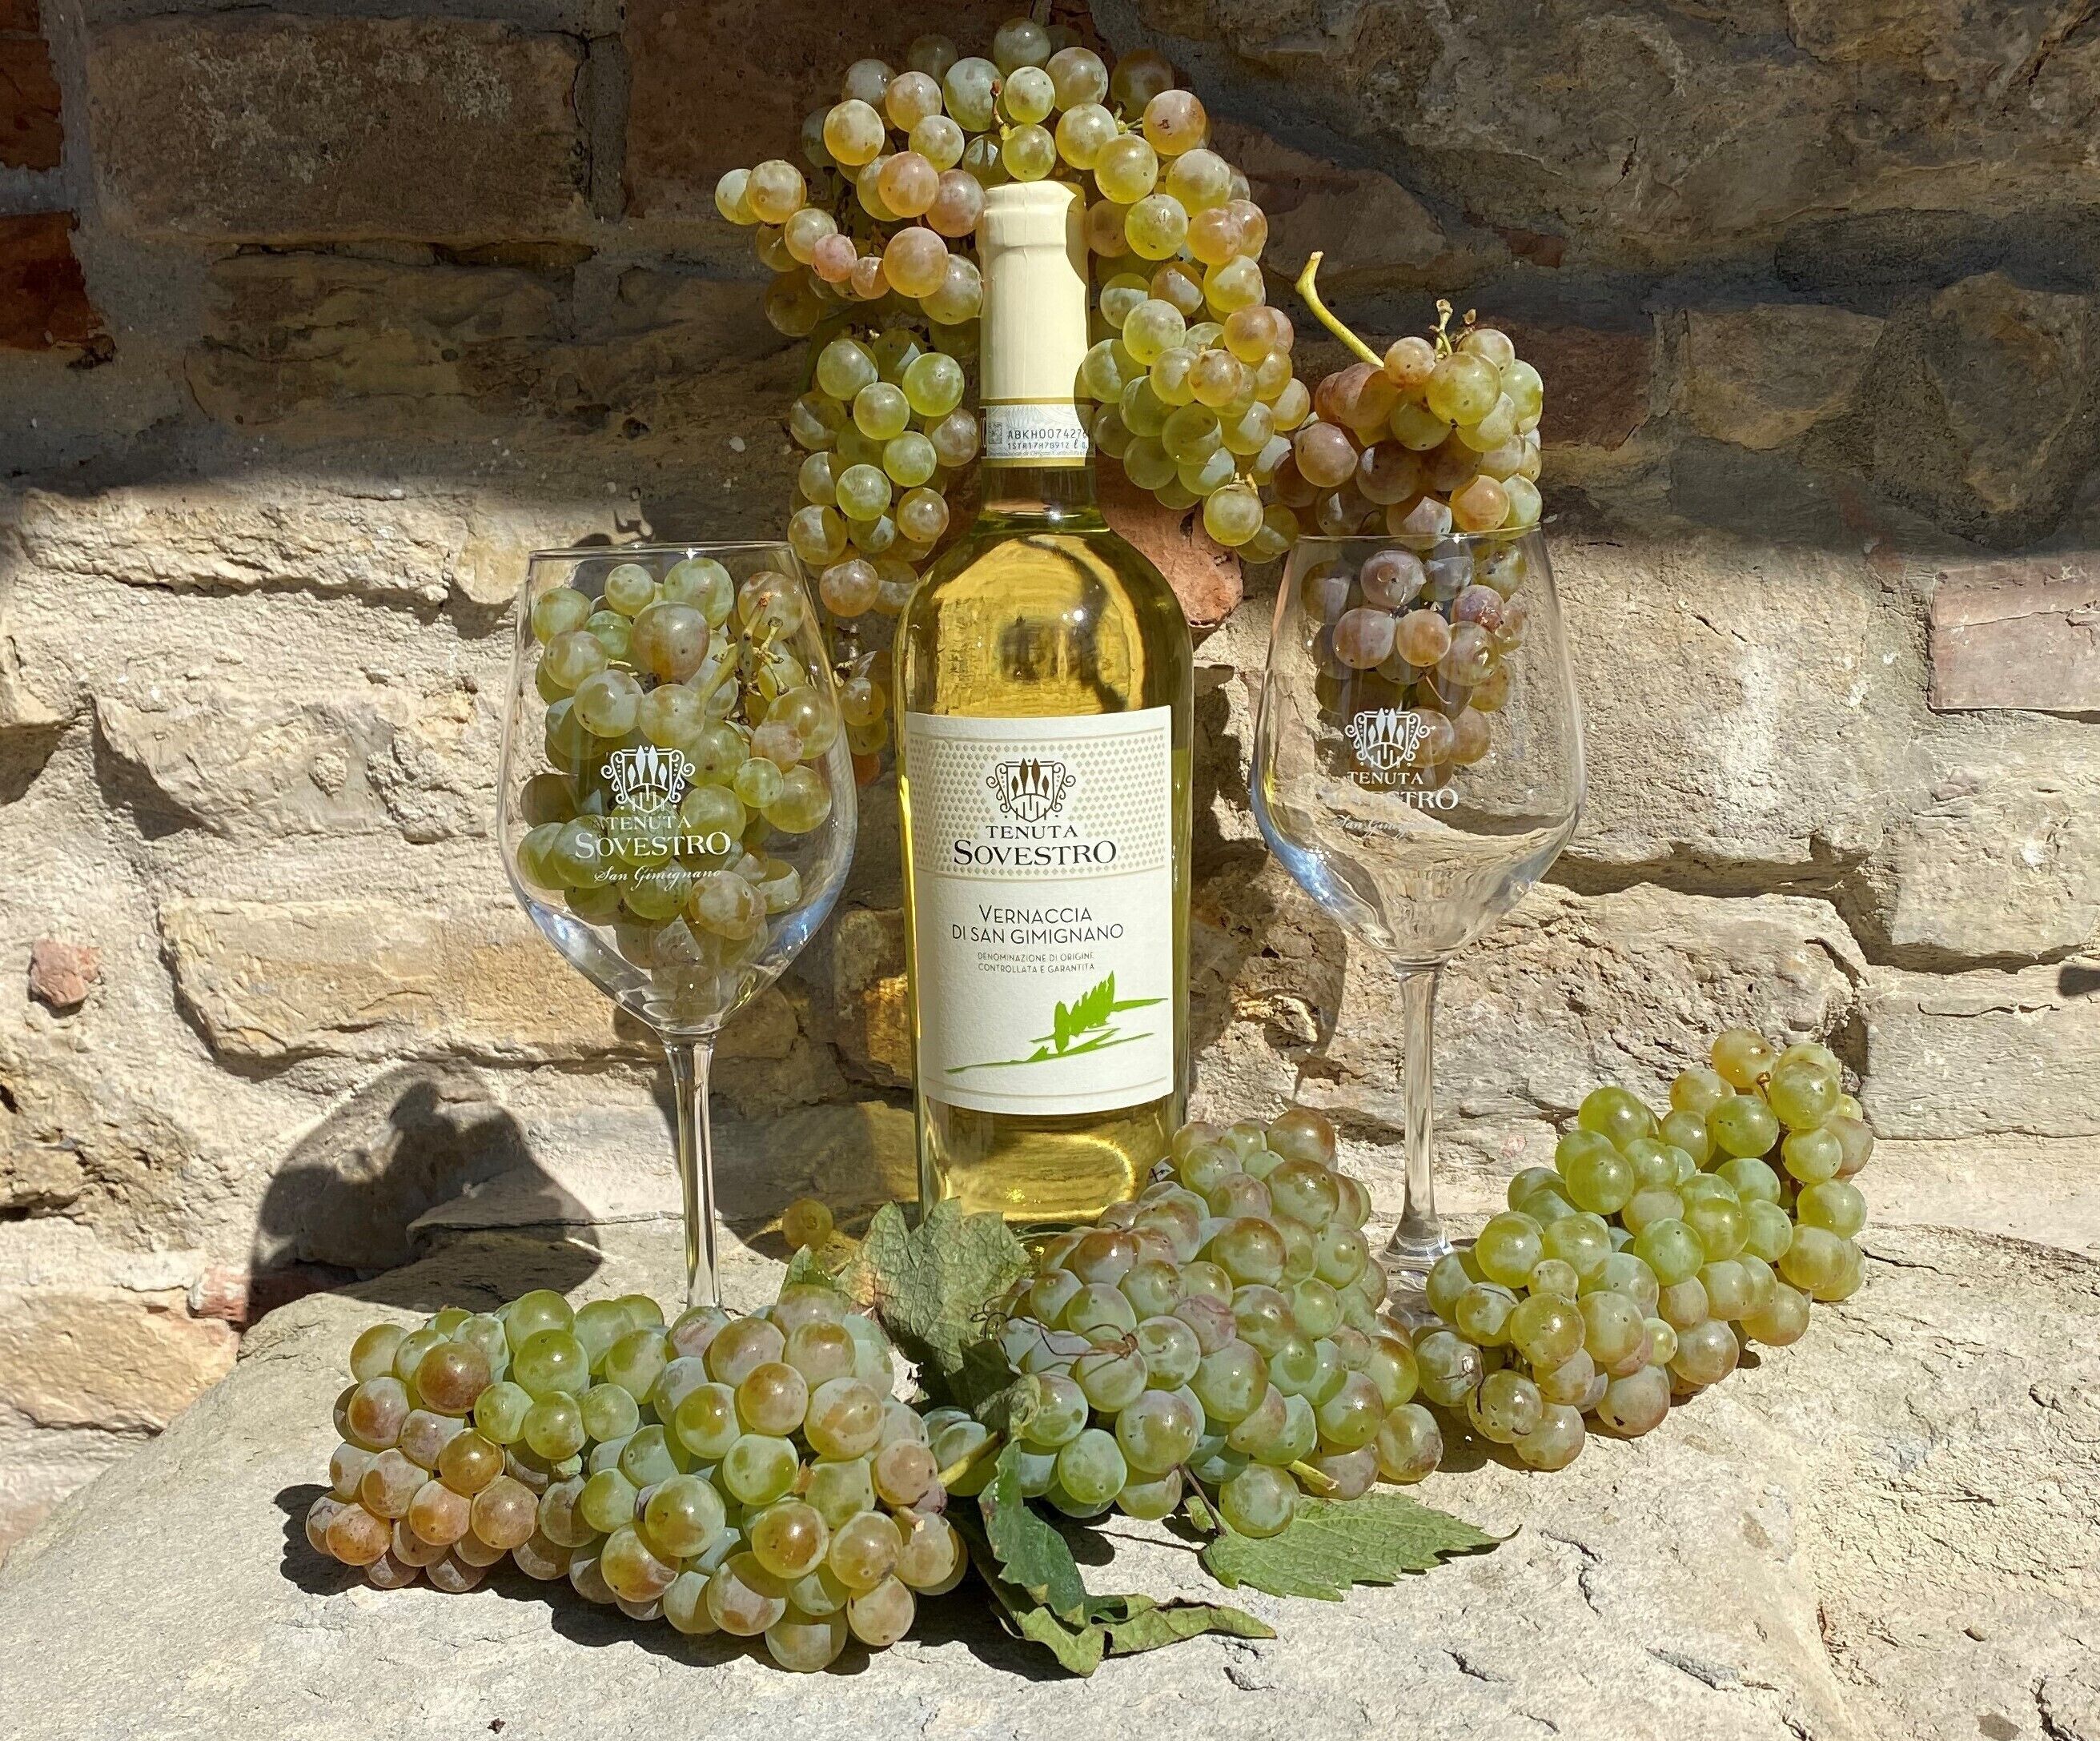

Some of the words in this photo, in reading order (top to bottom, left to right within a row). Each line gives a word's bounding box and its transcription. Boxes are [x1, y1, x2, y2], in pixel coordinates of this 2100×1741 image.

[1347, 771, 1423, 785] TENUTA
[607, 815, 692, 830] TENUTA
[985, 824, 1078, 840] TENUTA
[574, 830, 731, 859] SOVESTRO
[953, 839, 1117, 866] SOVESTRO
[594, 865, 628, 883] San
[630, 864, 721, 892] Gimignano
[978, 905, 1092, 925] VERNACCIA
[952, 924, 966, 940] DI
[970, 926, 1005, 944] SAN
[1010, 924, 1123, 945] GIMIGNANO
[978, 952, 1046, 962] DENOMINAZIONE
[1049, 953, 1058, 962] DI
[1060, 952, 1094, 962] ORIGINE
[978, 963, 1038, 973] CONTROLLATA
[1040, 965, 1045, 973] E
[1047, 963, 1095, 973] GARANTITA
